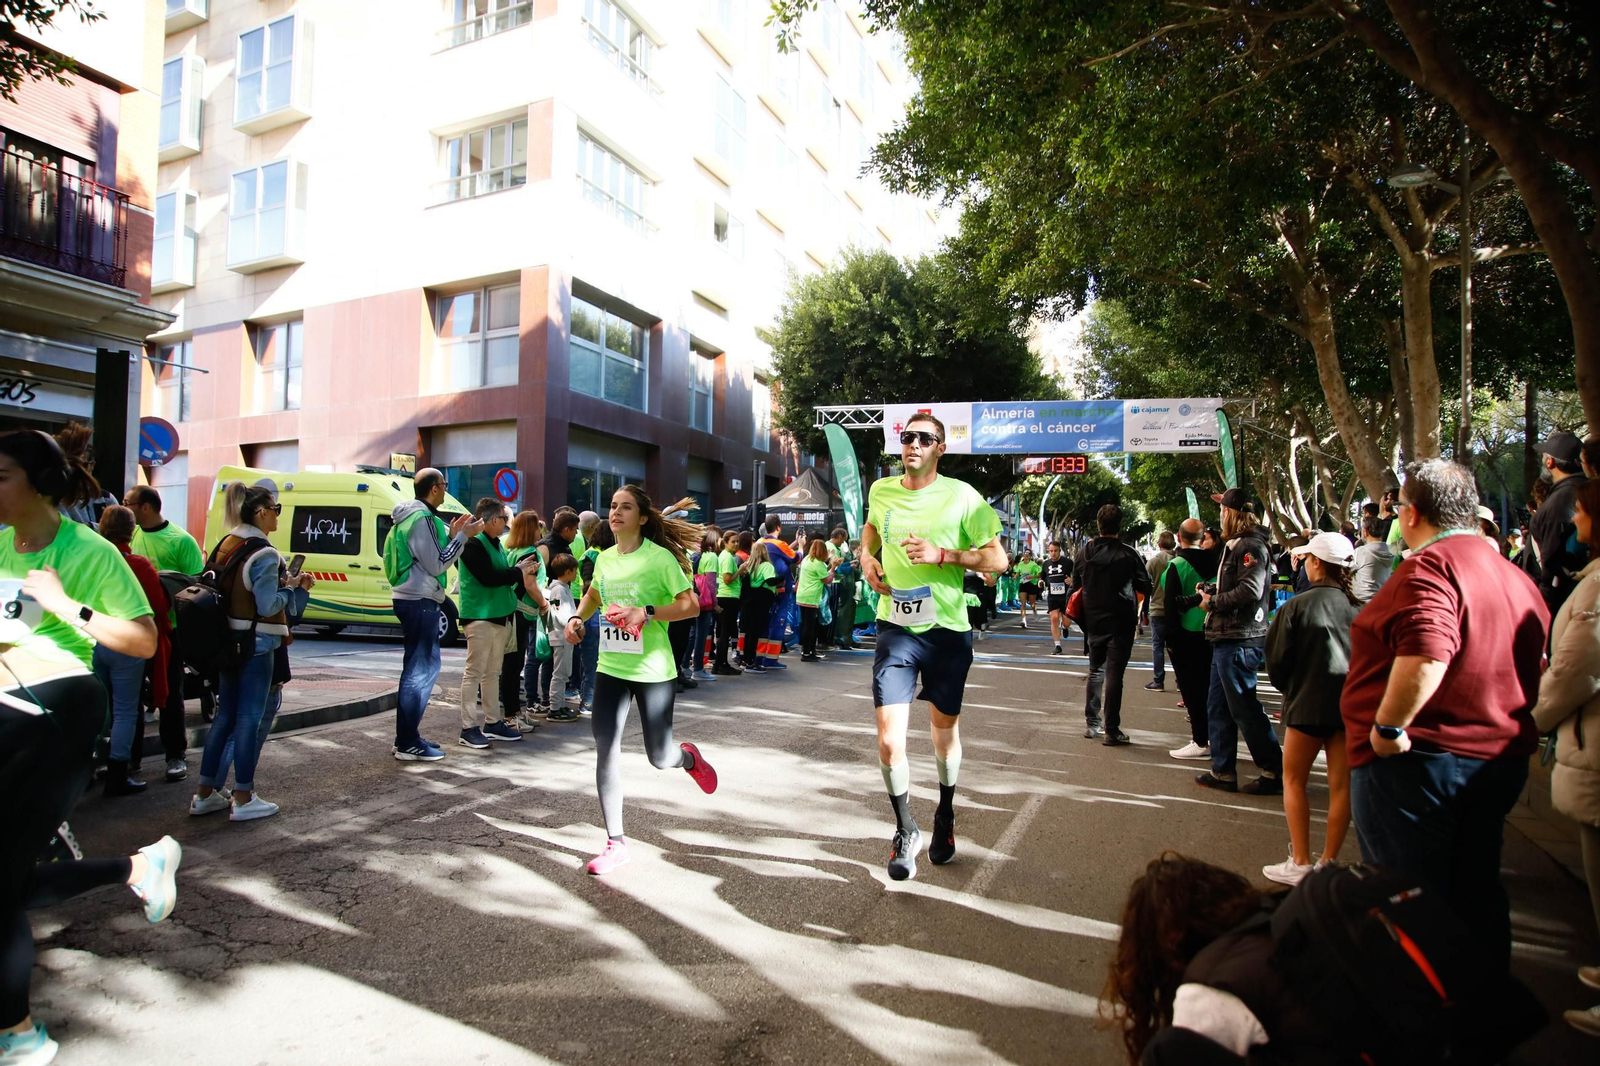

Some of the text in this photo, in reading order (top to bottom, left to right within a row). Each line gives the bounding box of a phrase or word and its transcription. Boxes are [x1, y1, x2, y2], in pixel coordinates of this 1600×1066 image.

[981, 406, 1115, 419] Almería en marcha
[1141, 406, 1170, 414] cajamar
[981, 423, 1026, 434] contra
[1029, 422, 1043, 434] el
[1047, 421, 1097, 434] cáncer
[893, 599, 923, 614] 767
